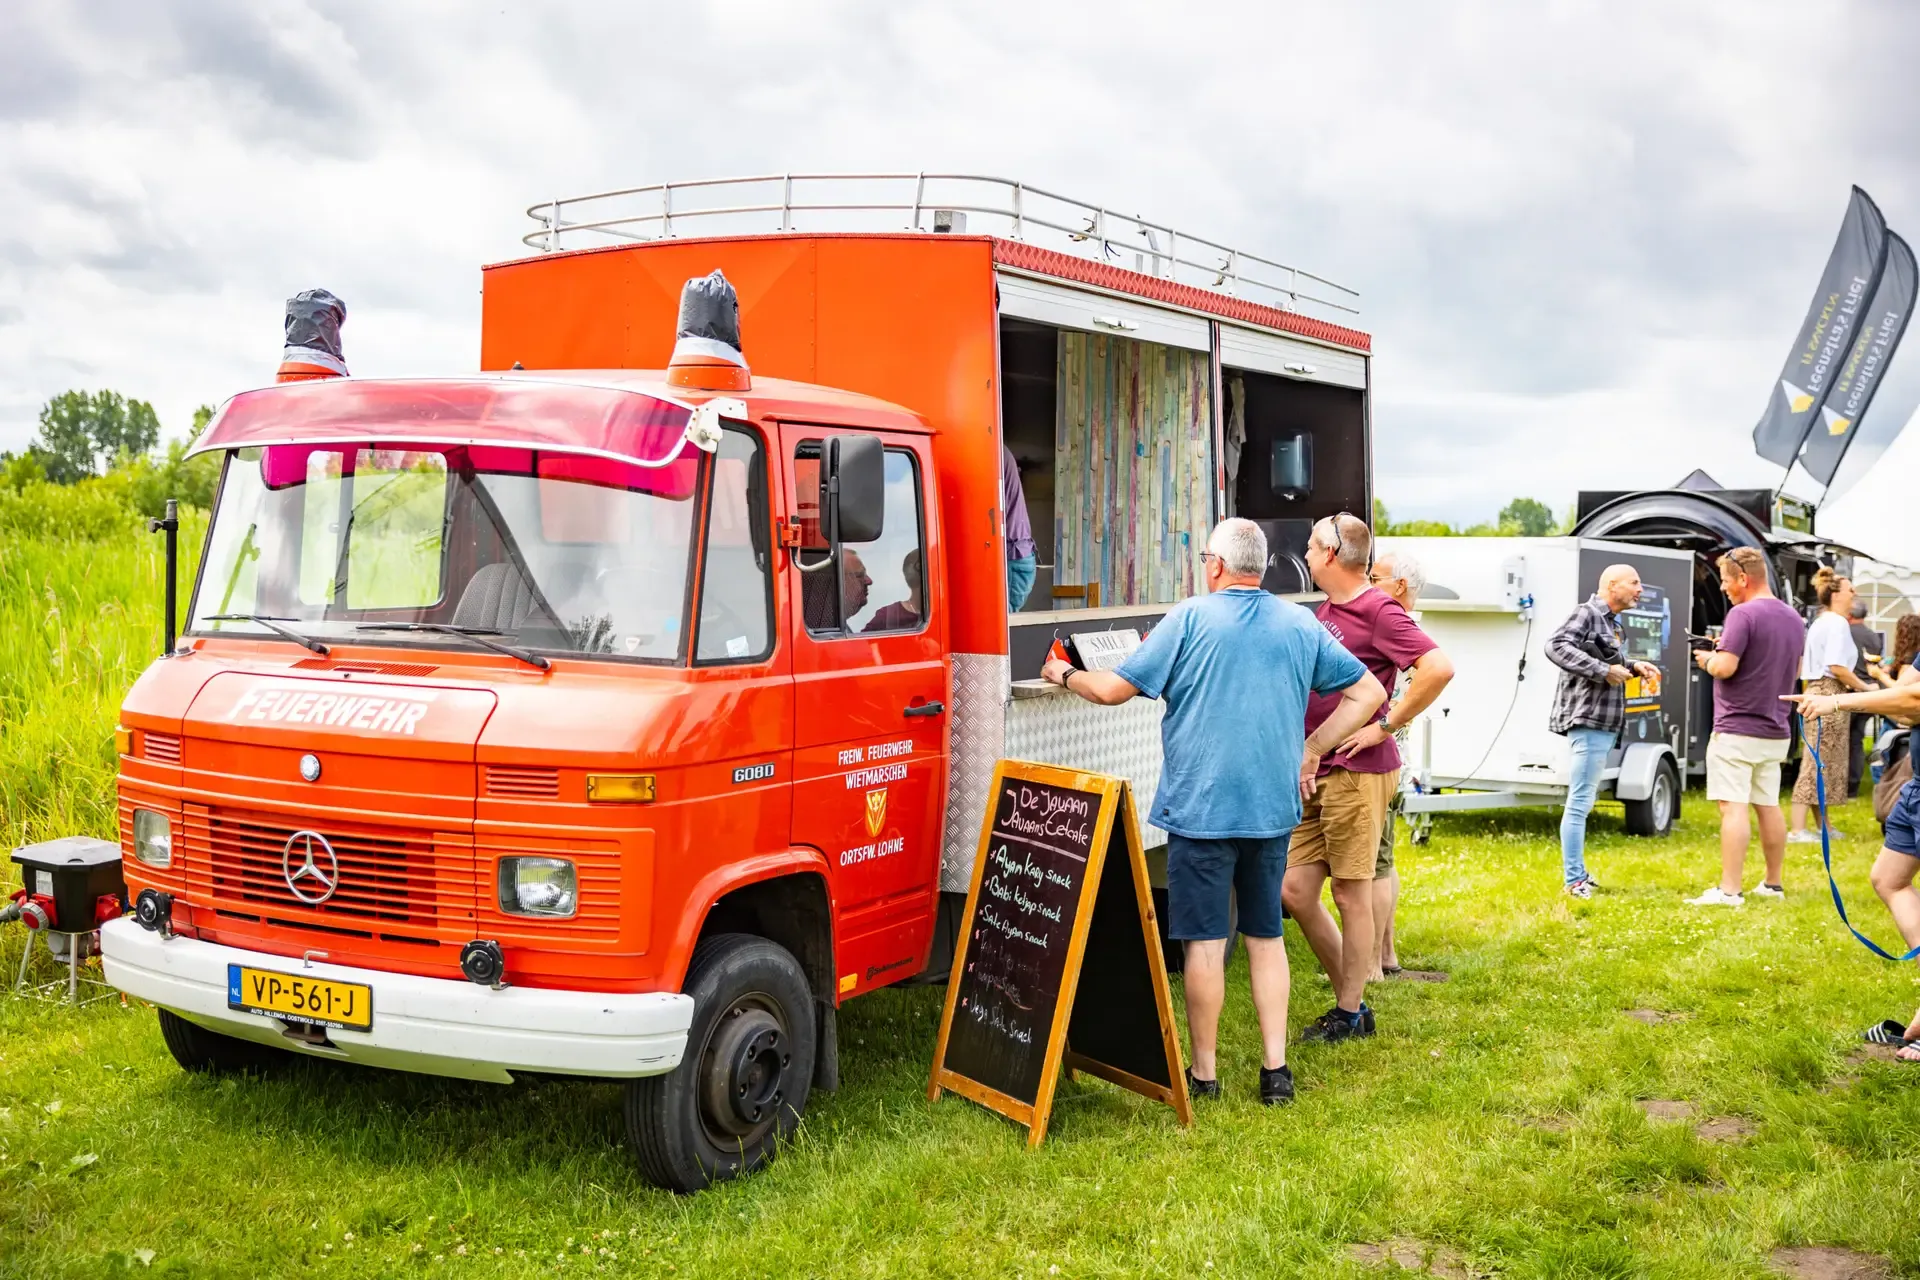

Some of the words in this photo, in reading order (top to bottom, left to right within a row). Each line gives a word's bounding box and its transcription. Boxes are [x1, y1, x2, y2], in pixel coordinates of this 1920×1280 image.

[228, 682, 436, 735] FEUERWEHR
[838, 747, 865, 767] FREIW.
[867, 739, 913, 762] FEUERWEHR
[734, 764, 775, 782] 608D
[845, 763, 908, 790] WIETMARSCHEN
[1020, 786, 1039, 810] De
[839, 845, 876, 868] ORTSFW.
[877, 836, 905, 858] LOHNE
[231, 987, 241, 997] NL
[252, 974, 354, 1017] VP-561-J
[250, 1008, 264, 1016] AUTO
